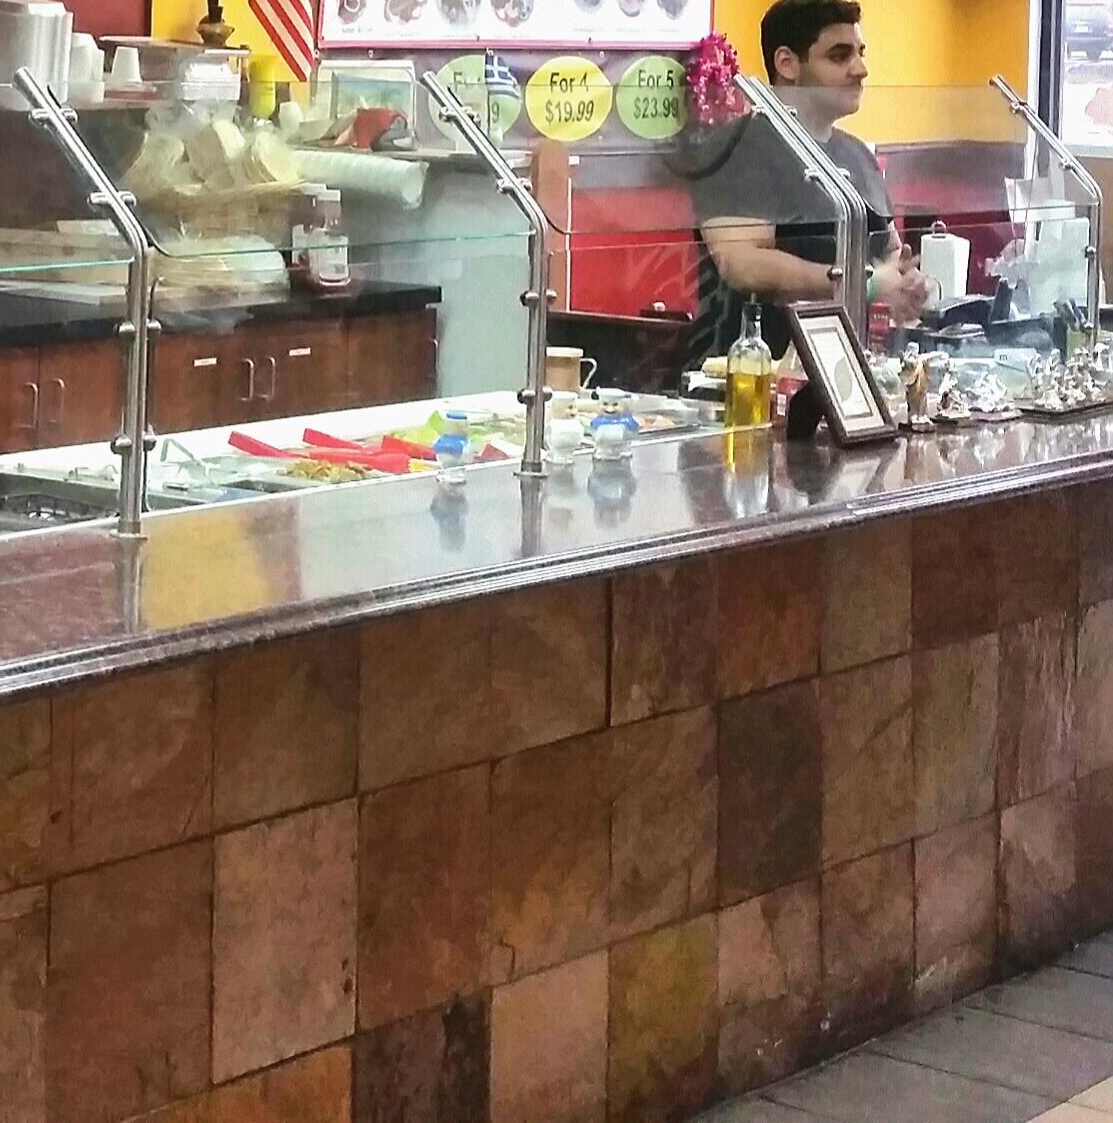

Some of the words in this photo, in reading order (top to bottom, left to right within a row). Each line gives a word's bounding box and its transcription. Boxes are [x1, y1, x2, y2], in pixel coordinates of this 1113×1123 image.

[550, 73, 576, 94] For
[638, 70, 663, 89] For
[666, 70, 674, 86] 5
[545, 100, 594, 124] $19.99
[634, 97, 679, 119] $23.99
